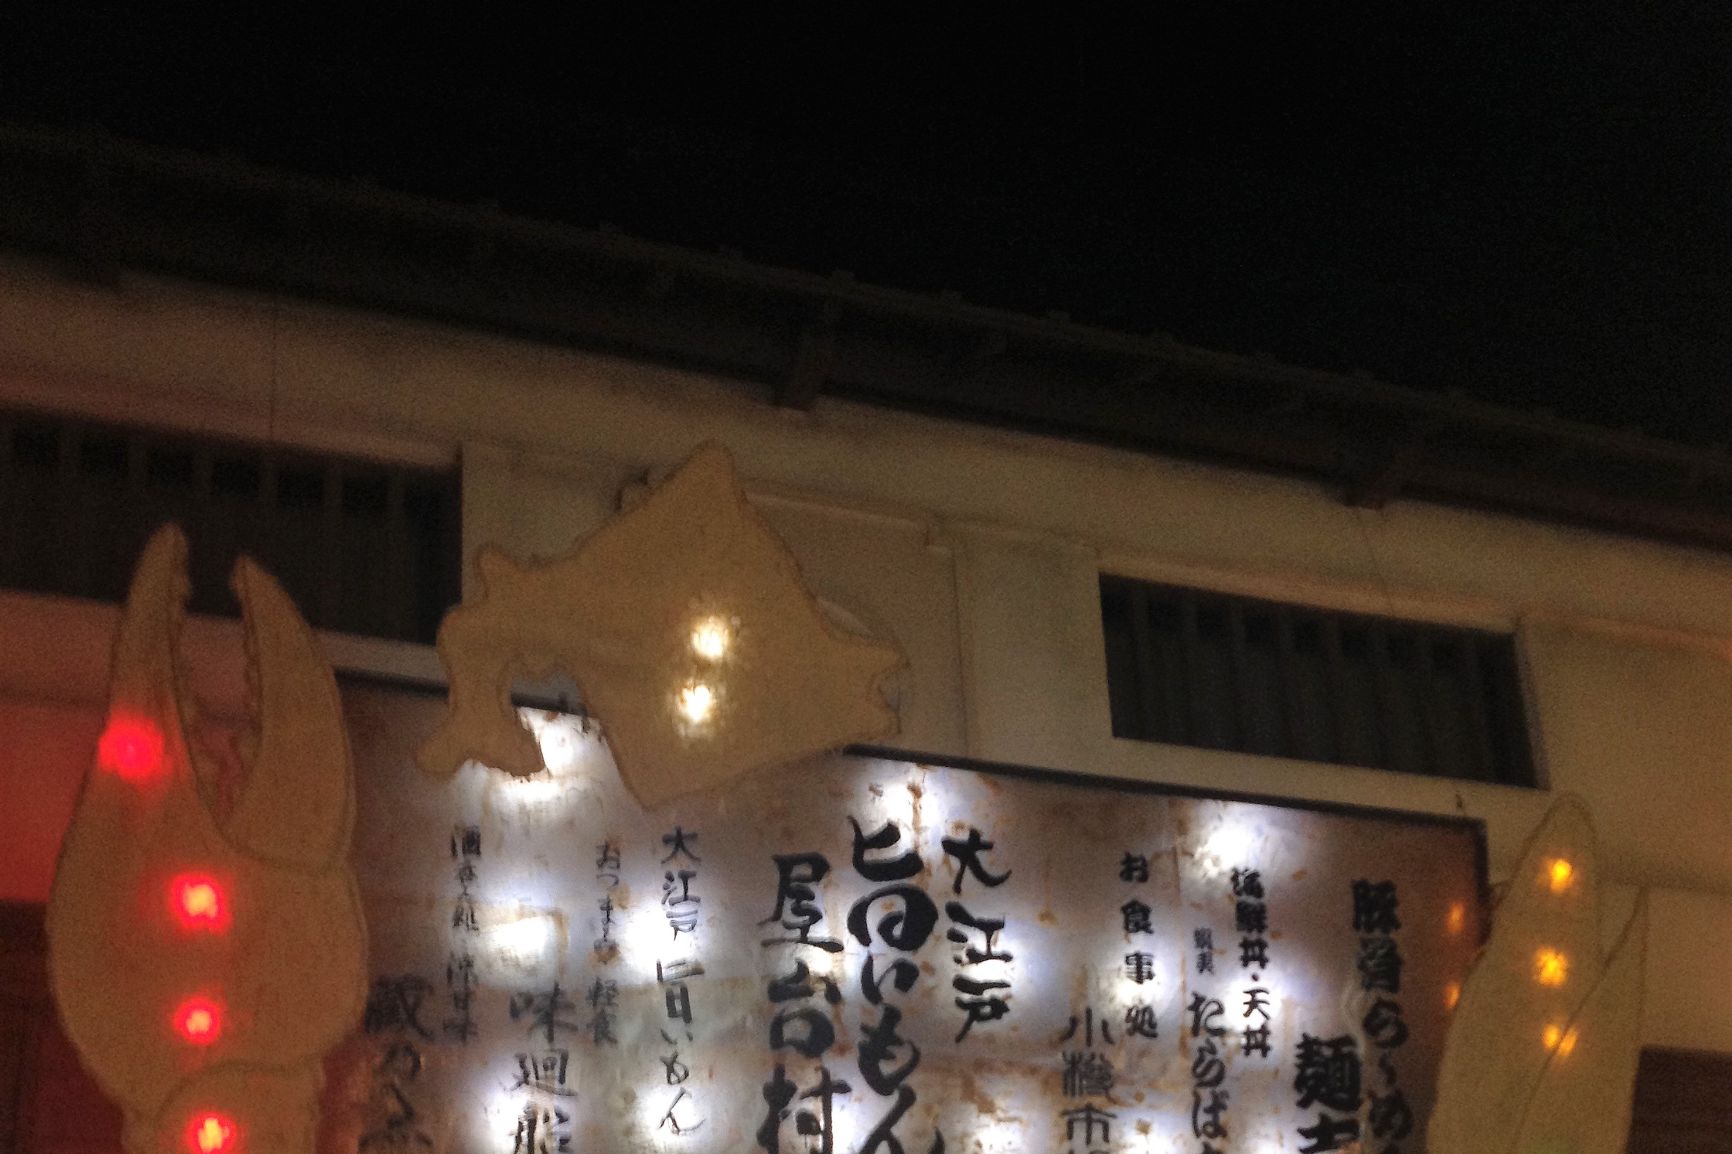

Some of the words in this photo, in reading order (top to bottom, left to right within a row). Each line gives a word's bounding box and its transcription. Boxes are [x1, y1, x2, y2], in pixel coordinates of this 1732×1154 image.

[941, 828, 1014, 1043] 大江戸
[1119, 852, 1160, 1039] お食事処
